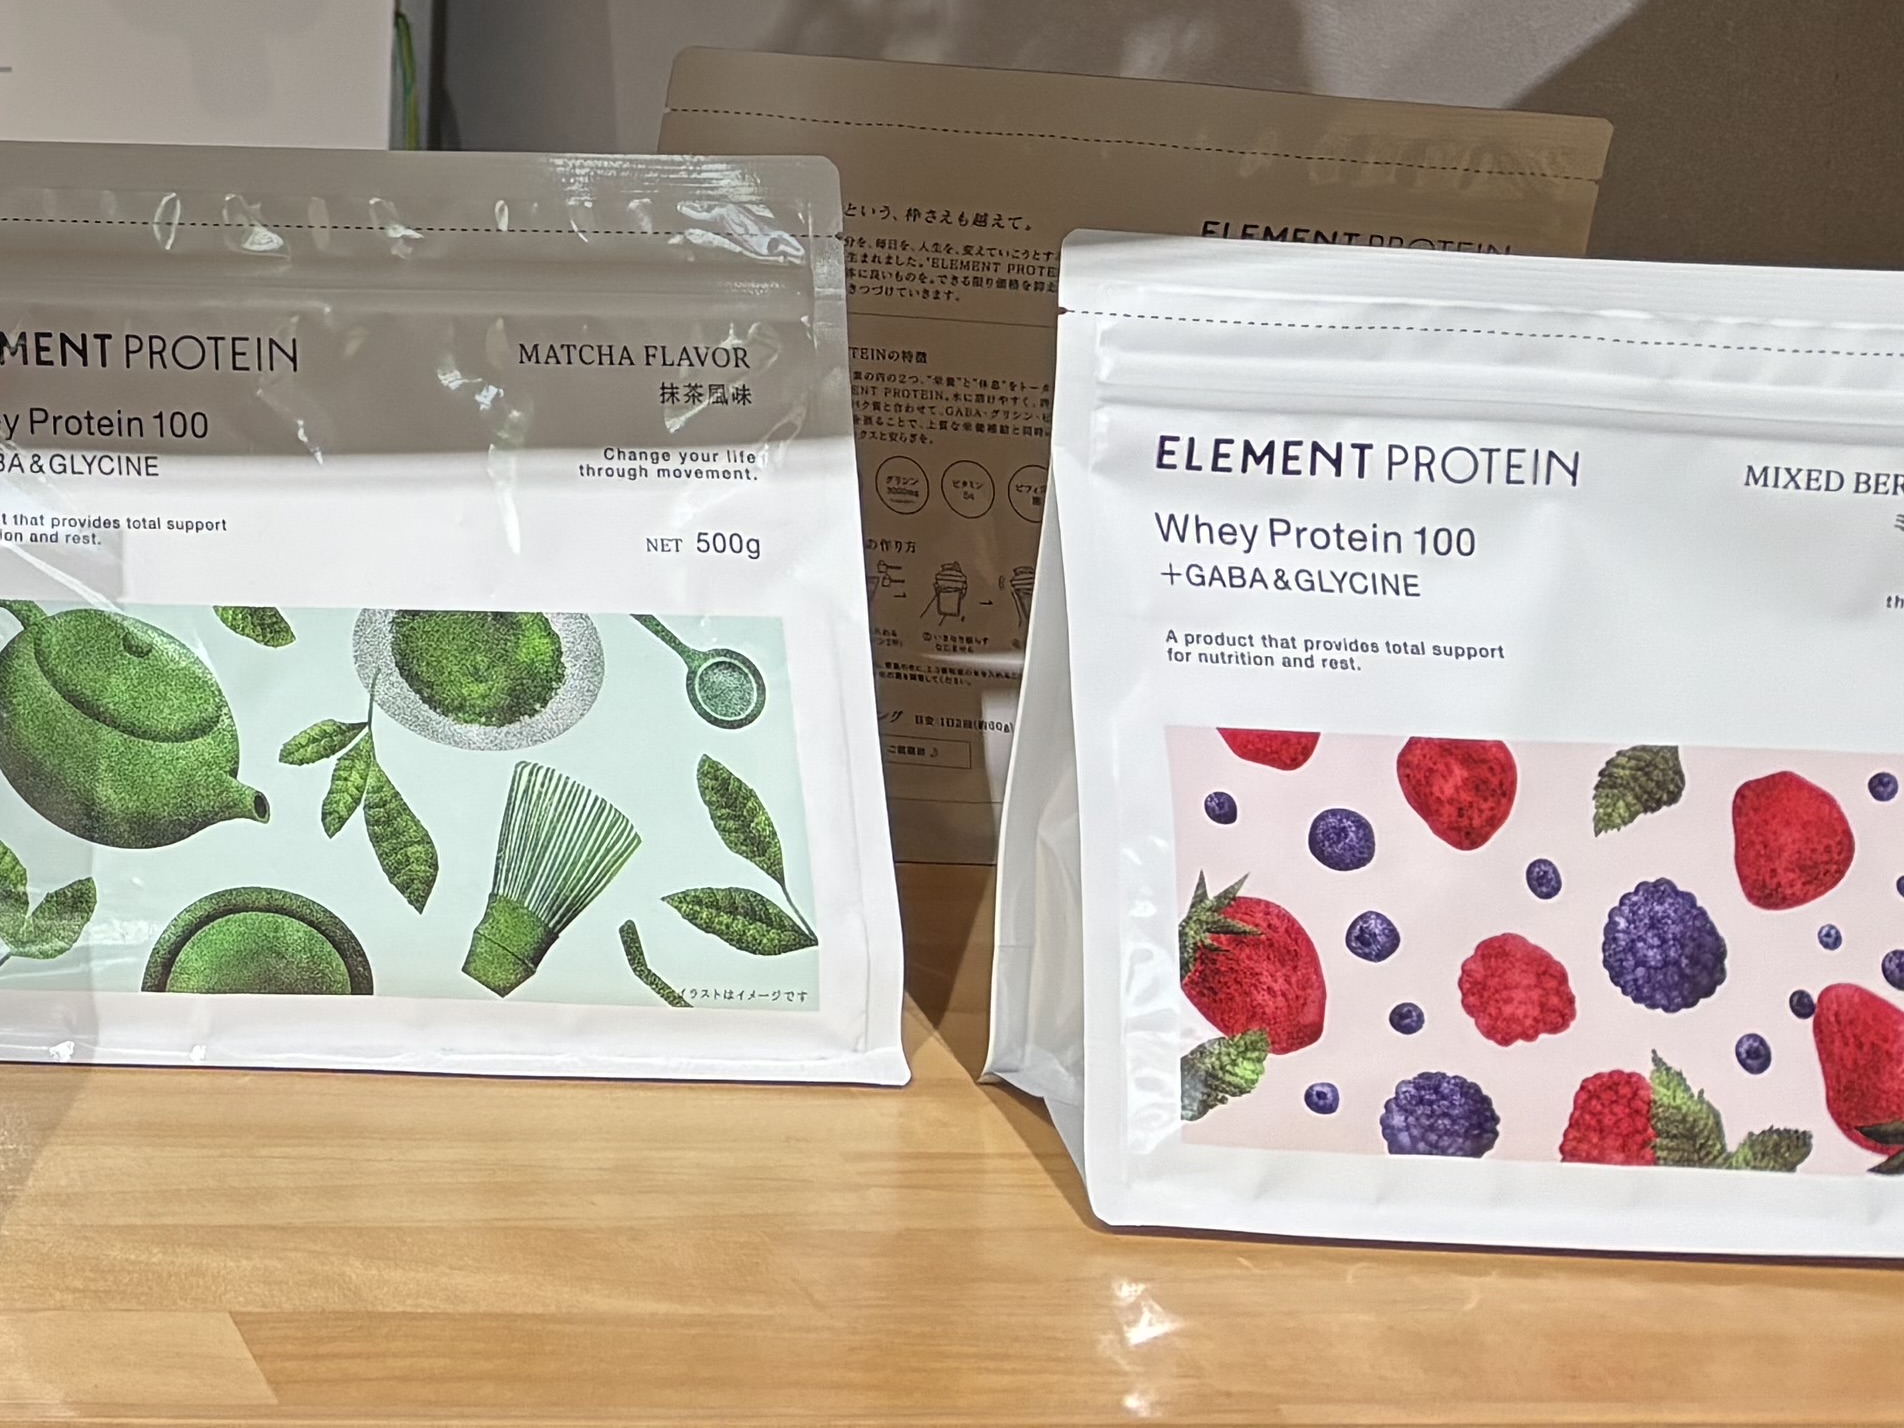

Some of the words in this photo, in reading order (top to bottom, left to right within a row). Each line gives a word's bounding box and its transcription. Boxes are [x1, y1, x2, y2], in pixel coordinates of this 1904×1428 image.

[125, 333, 299, 373] PROTEIN
[519, 342, 635, 366] MATCHA
[644, 345, 751, 370] FLAVOR
[659, 381, 753, 406] 抹茶風味
[29, 407, 144, 439] Protein
[152, 410, 209, 439] 100
[603, 447, 671, 463] Change
[679, 450, 719, 465] your
[726, 449, 756, 464] life
[1155, 435, 1373, 481] ELEMENT
[1388, 442, 1580, 487] PROTEIN
[579, 464, 649, 481] through
[656, 467, 758, 481] movement.
[1744, 465, 1845, 493] MIXED
[12, 513, 45, 528] that
[51, 515, 120, 532] provides
[126, 516, 161, 531] total
[166, 517, 227, 534] support
[29, 530, 59, 544] and
[65, 531, 102, 545] rest.
[1155, 512, 1258, 555] Whey
[1269, 518, 1402, 556] Protein
[1414, 525, 1476, 558] 100
[645, 537, 683, 553] NET
[695, 531, 761, 560] 500g
[1160, 562, 1421, 599] +GABA&GLYCINE
[1166, 630, 1179, 645] A
[1184, 632, 1254, 651] product
[1260, 634, 1297, 651] that
[1302, 636, 1380, 655] provides
[1384, 640, 1426, 657] total
[1432, 642, 1505, 661] support
[1167, 648, 1192, 664] for
[1198, 649, 1275, 668] nutrition
[1282, 652, 1315, 669] and
[1321, 655, 1362, 672] rest.
